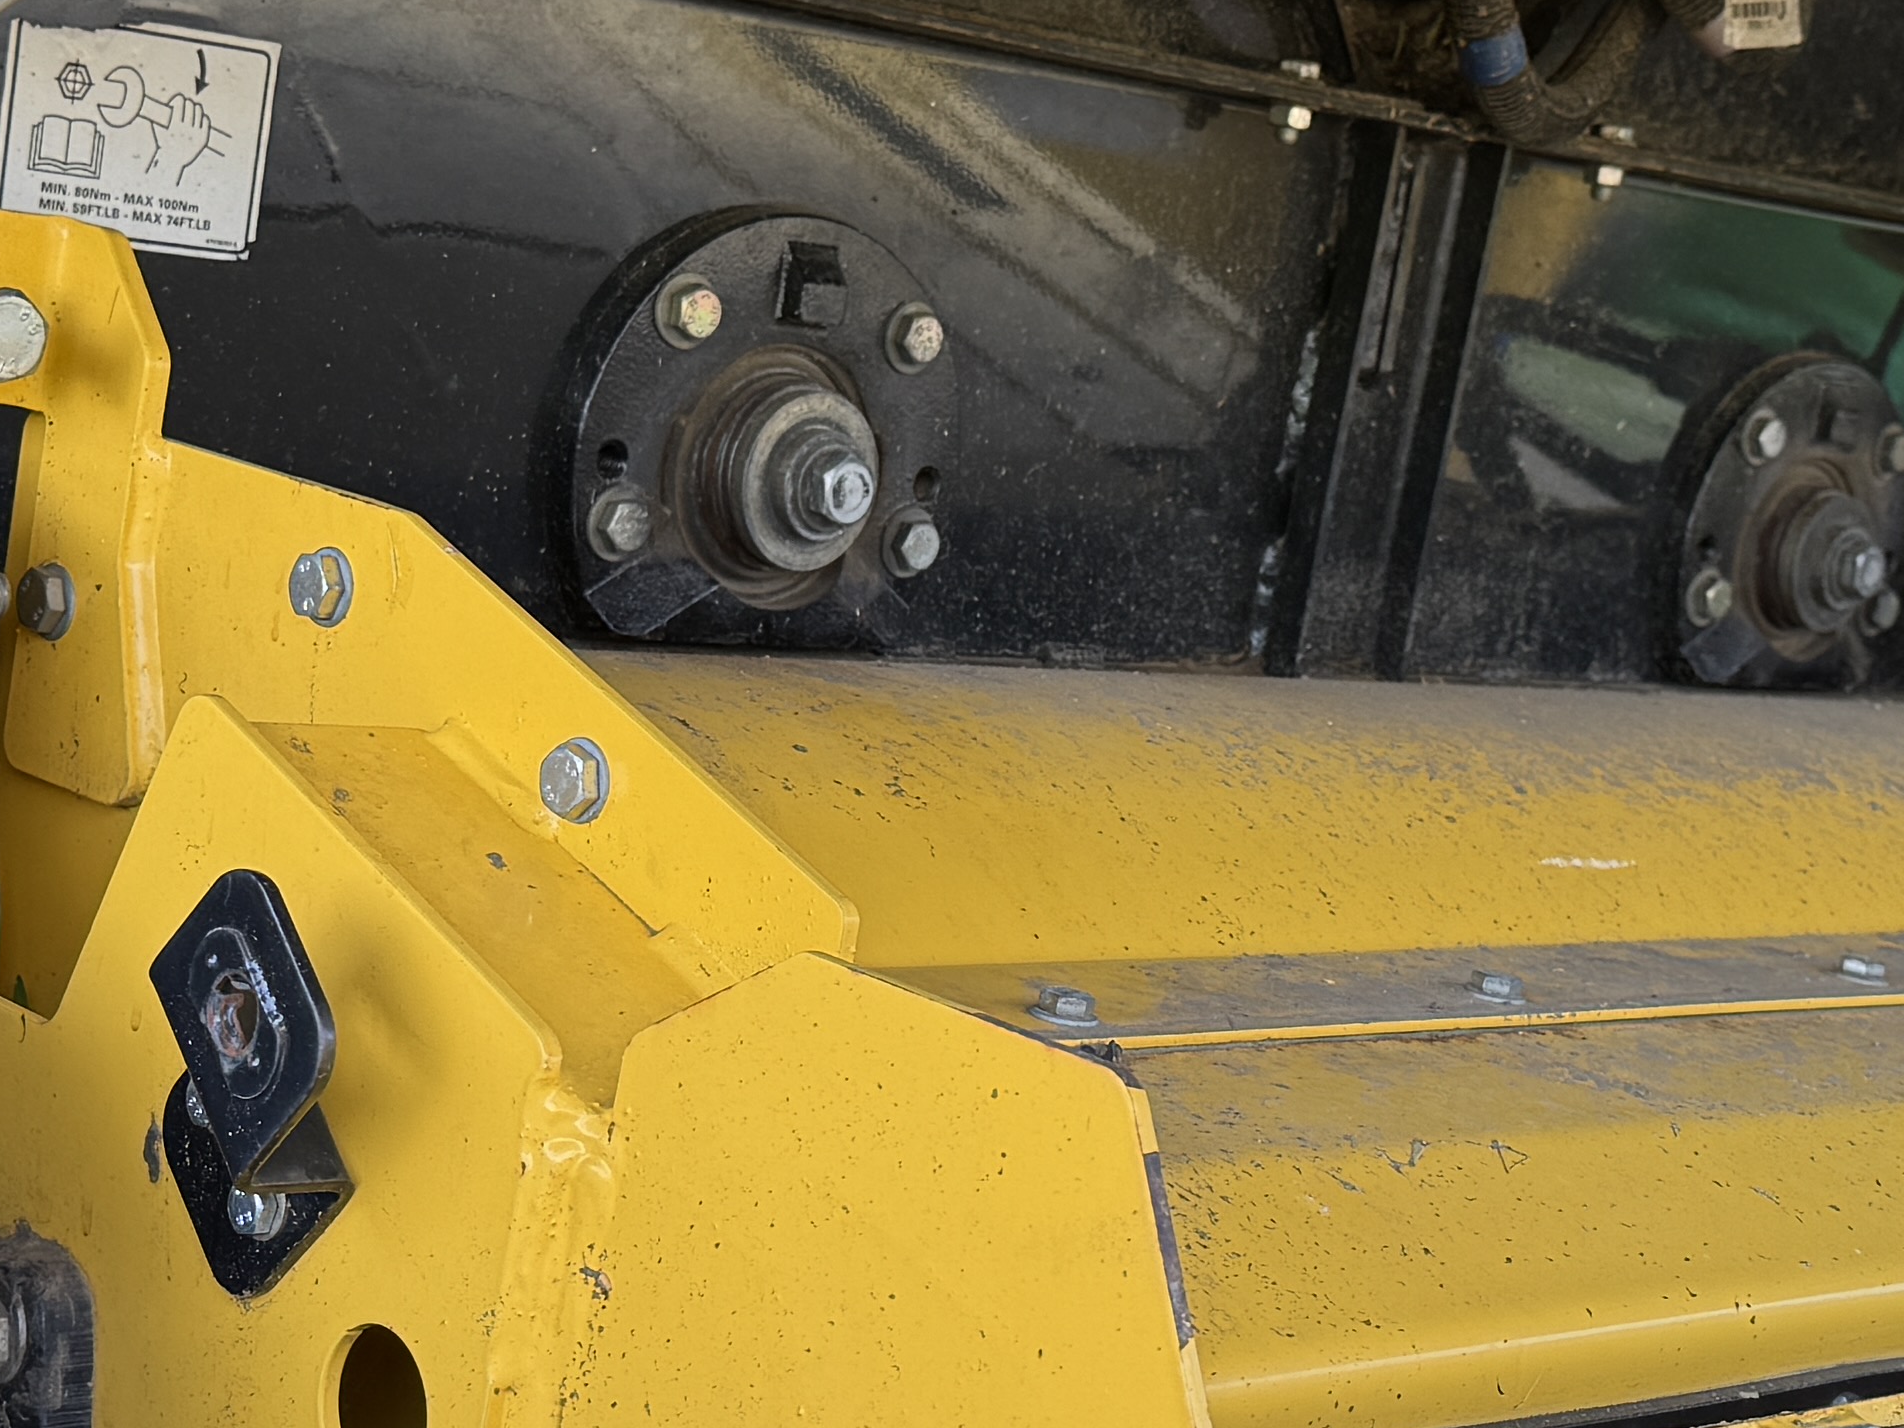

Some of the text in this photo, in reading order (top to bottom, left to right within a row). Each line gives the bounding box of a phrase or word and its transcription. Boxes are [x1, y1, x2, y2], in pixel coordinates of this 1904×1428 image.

[38, 197, 69, 213] MIN.
[132, 210, 162, 225] MAX
[41, 181, 71, 197] MIN.
[74, 186, 111, 202] 80Nm
[123, 192, 154, 208] MAX
[158, 198, 199, 213] 100Nm
